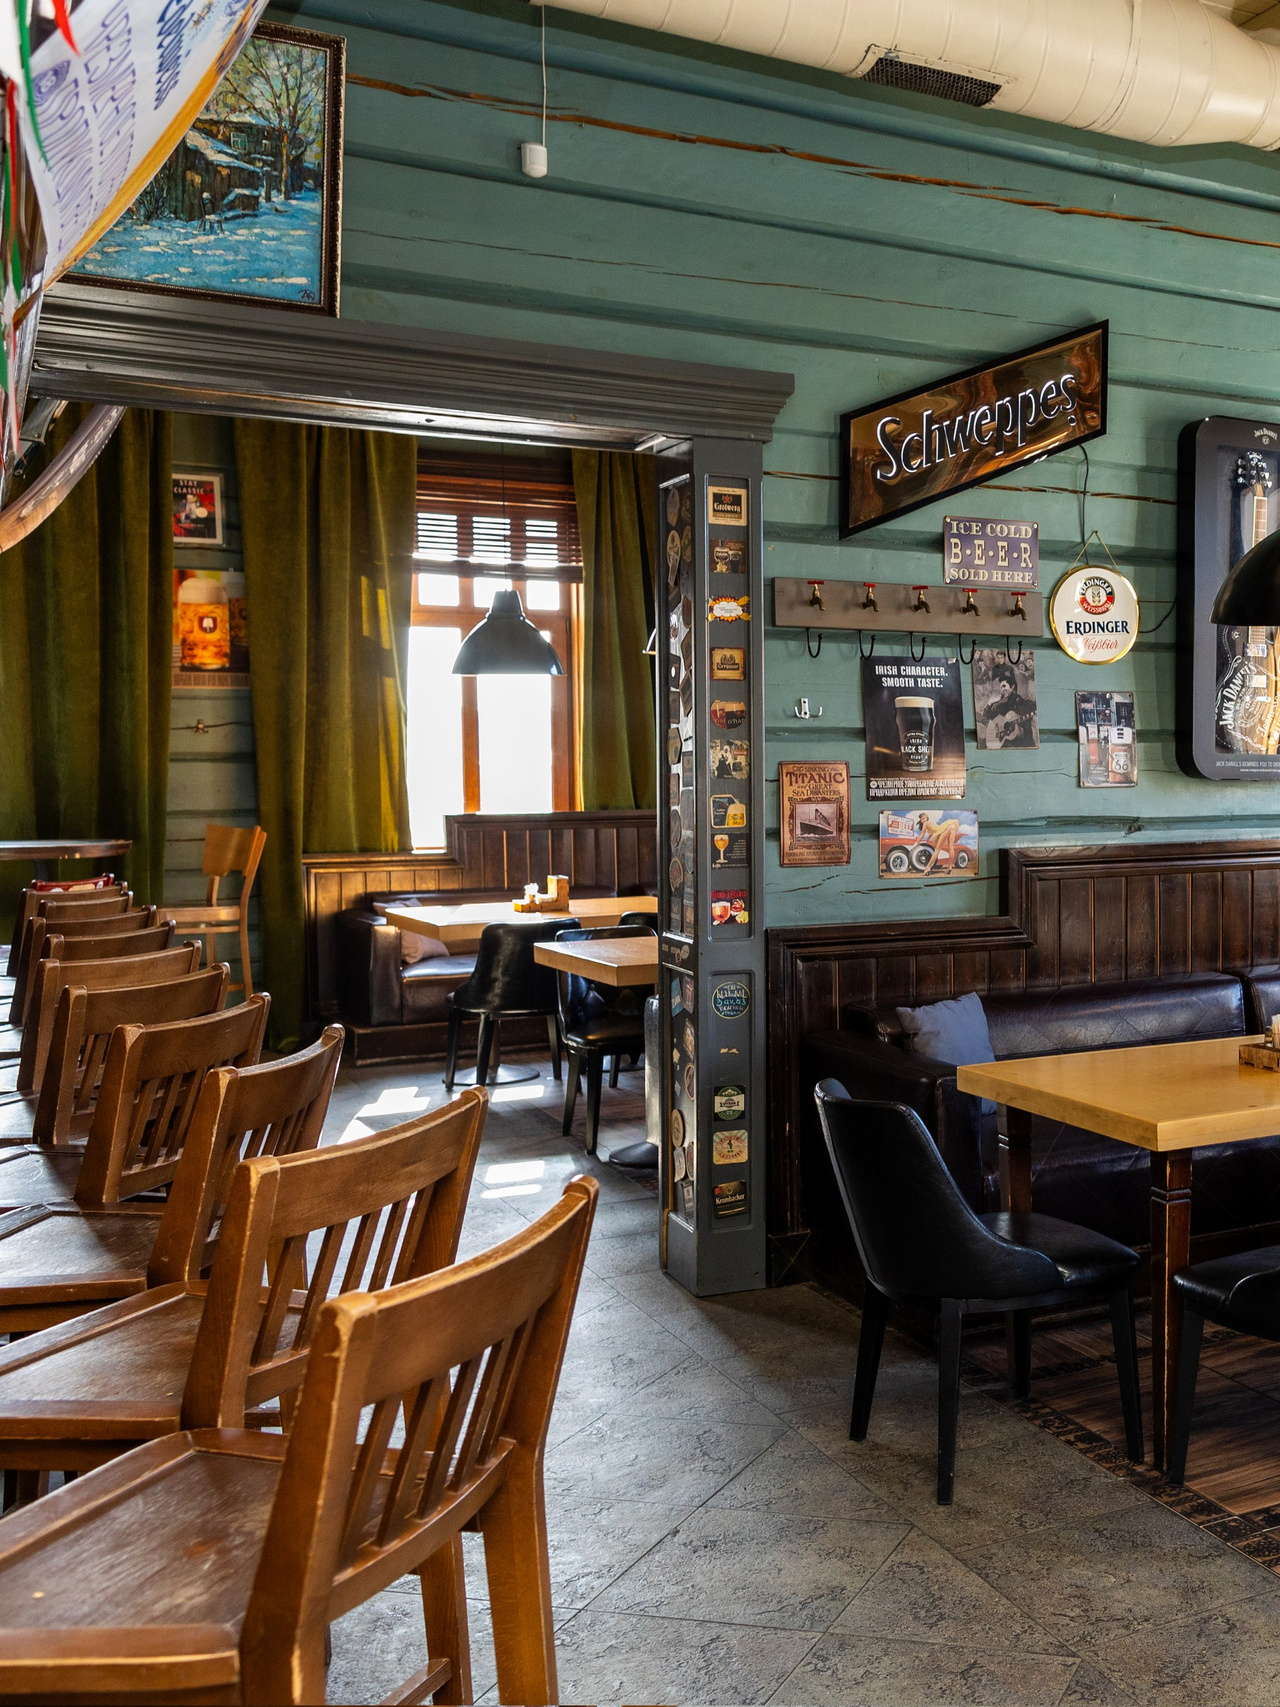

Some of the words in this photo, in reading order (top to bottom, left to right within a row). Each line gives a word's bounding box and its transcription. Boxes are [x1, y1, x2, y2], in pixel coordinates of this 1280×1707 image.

[876, 374, 1077, 481] Schweppes
[180, 479, 197, 487] STAY
[174, 487, 204, 495] CLASSIC
[950, 521, 982, 536] ICE
[986, 523, 1032, 539] COLD
[950, 567, 989, 580] SOLD
[991, 570, 1033, 583] HERE
[1080, 578, 1112, 594] ERDINGER
[1066, 620, 1130, 635] ERDINGER
[875, 665, 898, 675] IRISH
[900, 665, 948, 677] CHARACTER.
[881, 677, 915, 687] SMOOTH
[1219, 699, 1235, 730] JACK
[1115, 759, 1129, 771] 66
[785, 771, 845, 787] TITANIC
[715, 1193, 745, 1205] Krombacher
